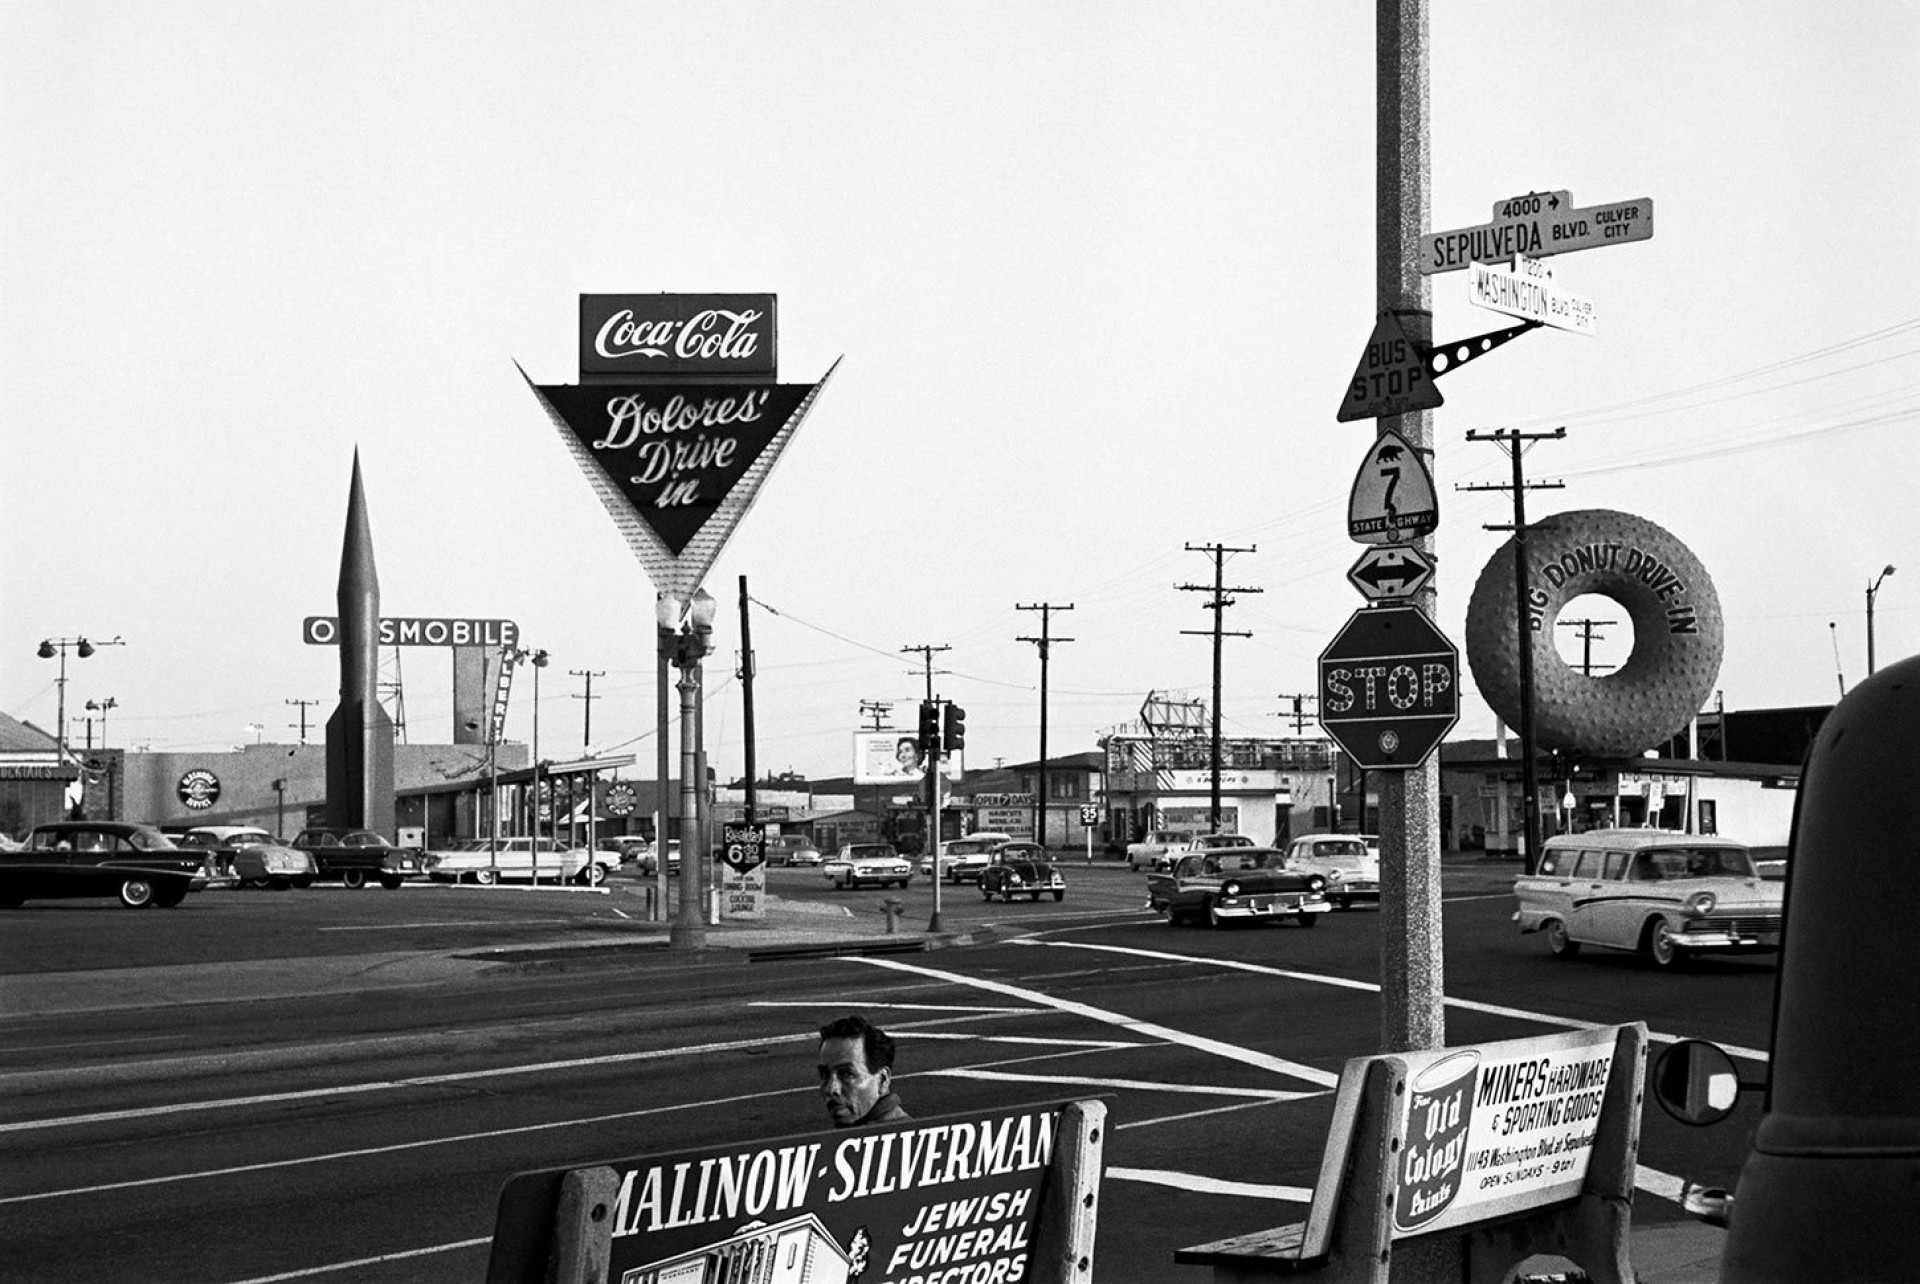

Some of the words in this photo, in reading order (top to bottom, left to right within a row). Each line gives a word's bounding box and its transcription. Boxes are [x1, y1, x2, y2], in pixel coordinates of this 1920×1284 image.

[1502, 197, 1541, 218] 4000
[1595, 206, 1639, 225] CULVER
[1433, 221, 1542, 267] SEPULVEDA
[1552, 220, 1590, 241] BLVD.
[1604, 223, 1630, 239] CITY
[1477, 268, 1548, 316] WASHINGTON
[595, 309, 763, 358] Coca-Cola
[1368, 338, 1406, 368] BUS
[1353, 366, 1422, 402] STOP
[592, 389, 770, 450] Dolores'
[630, 434, 737, 484] Drive
[655, 471, 700, 509] in
[1380, 467, 1400, 512] 7
[1352, 519, 1383, 533] STATE
[1385, 513, 1432, 529] HGHWAY
[1541, 543, 1622, 589] DONUT
[1624, 548, 1698, 634] DRIVE-IN
[310, 619, 514, 644] OSMOBILE
[1327, 664, 1450, 712] STOP
[976, 795, 998, 806] OPEN
[1082, 808, 1096, 819] 35
[728, 844, 744, 863] 6
[1477, 1058, 1550, 1108] MINERS
[1546, 1057, 1610, 1095] HARDWARE
[1424, 1089, 1463, 1141] Old
[1502, 1097, 1563, 1136] SPORTING
[1562, 1090, 1602, 1125] GOODS
[1405, 1126, 1468, 1186] Colony
[1480, 1174, 1501, 1190] OPEN
[1503, 1164, 1544, 1185] SUNDAYS
[1551, 1160, 1561, 1174] 9
[1489, 1145, 1537, 1168] Washington
[902, 1188, 1032, 1237] JEWISH
[1409, 1182, 1452, 1217] Paints
[885, 1221, 1028, 1275] FUNERAL
[880, 1253, 1028, 1284] CTORS
